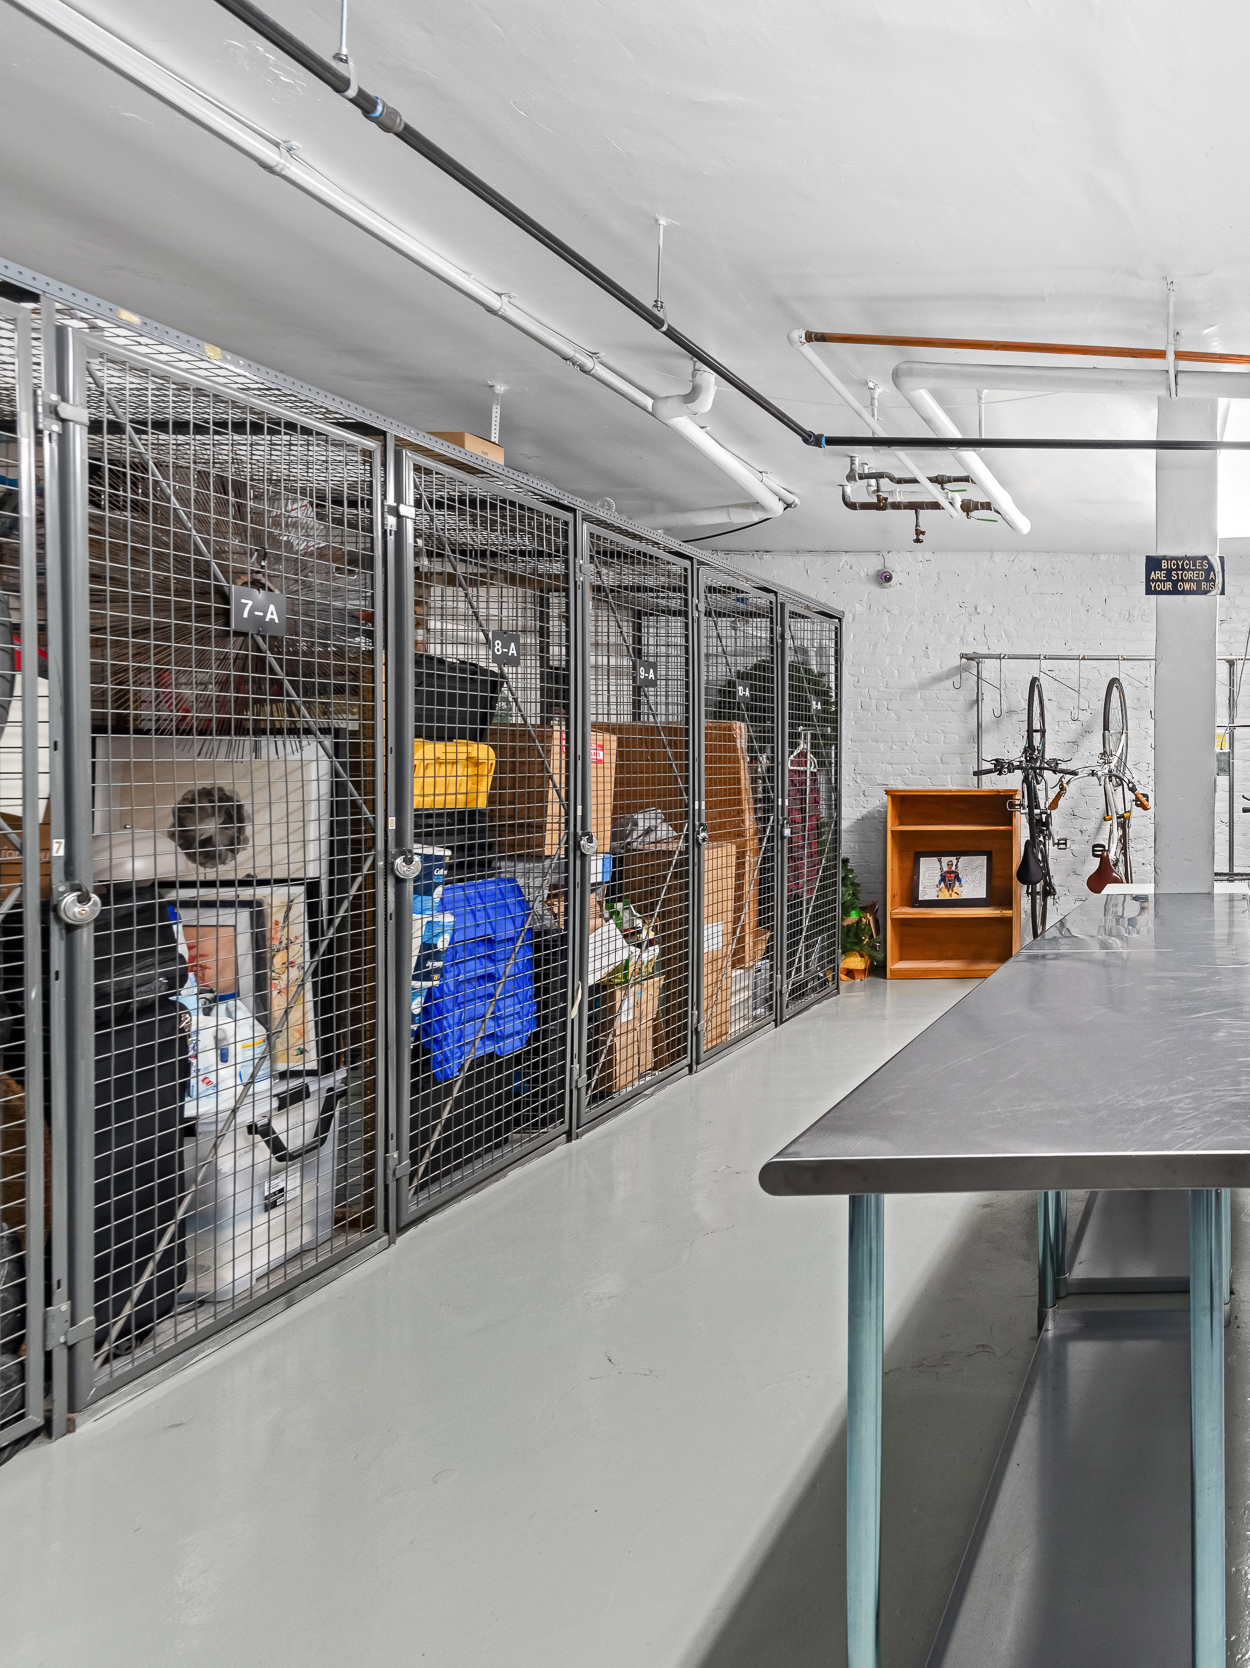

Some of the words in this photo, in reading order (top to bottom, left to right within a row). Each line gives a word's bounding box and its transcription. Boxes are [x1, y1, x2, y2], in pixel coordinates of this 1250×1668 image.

[1161, 560, 1209, 569] BICYCLES
[1150, 571, 1167, 580] ARE
[1171, 571, 1205, 580] STORED
[1150, 582, 1173, 591] YOUR
[1177, 582, 1197, 591] OWN
[1201, 582, 1220, 591] RISK
[240, 599, 279, 623] 7-A
[494, 640, 517, 657] 8-A
[639, 666, 655, 680] 9-A
[738, 686, 750, 697] 10-A
[54, 841, 62, 854] 7
